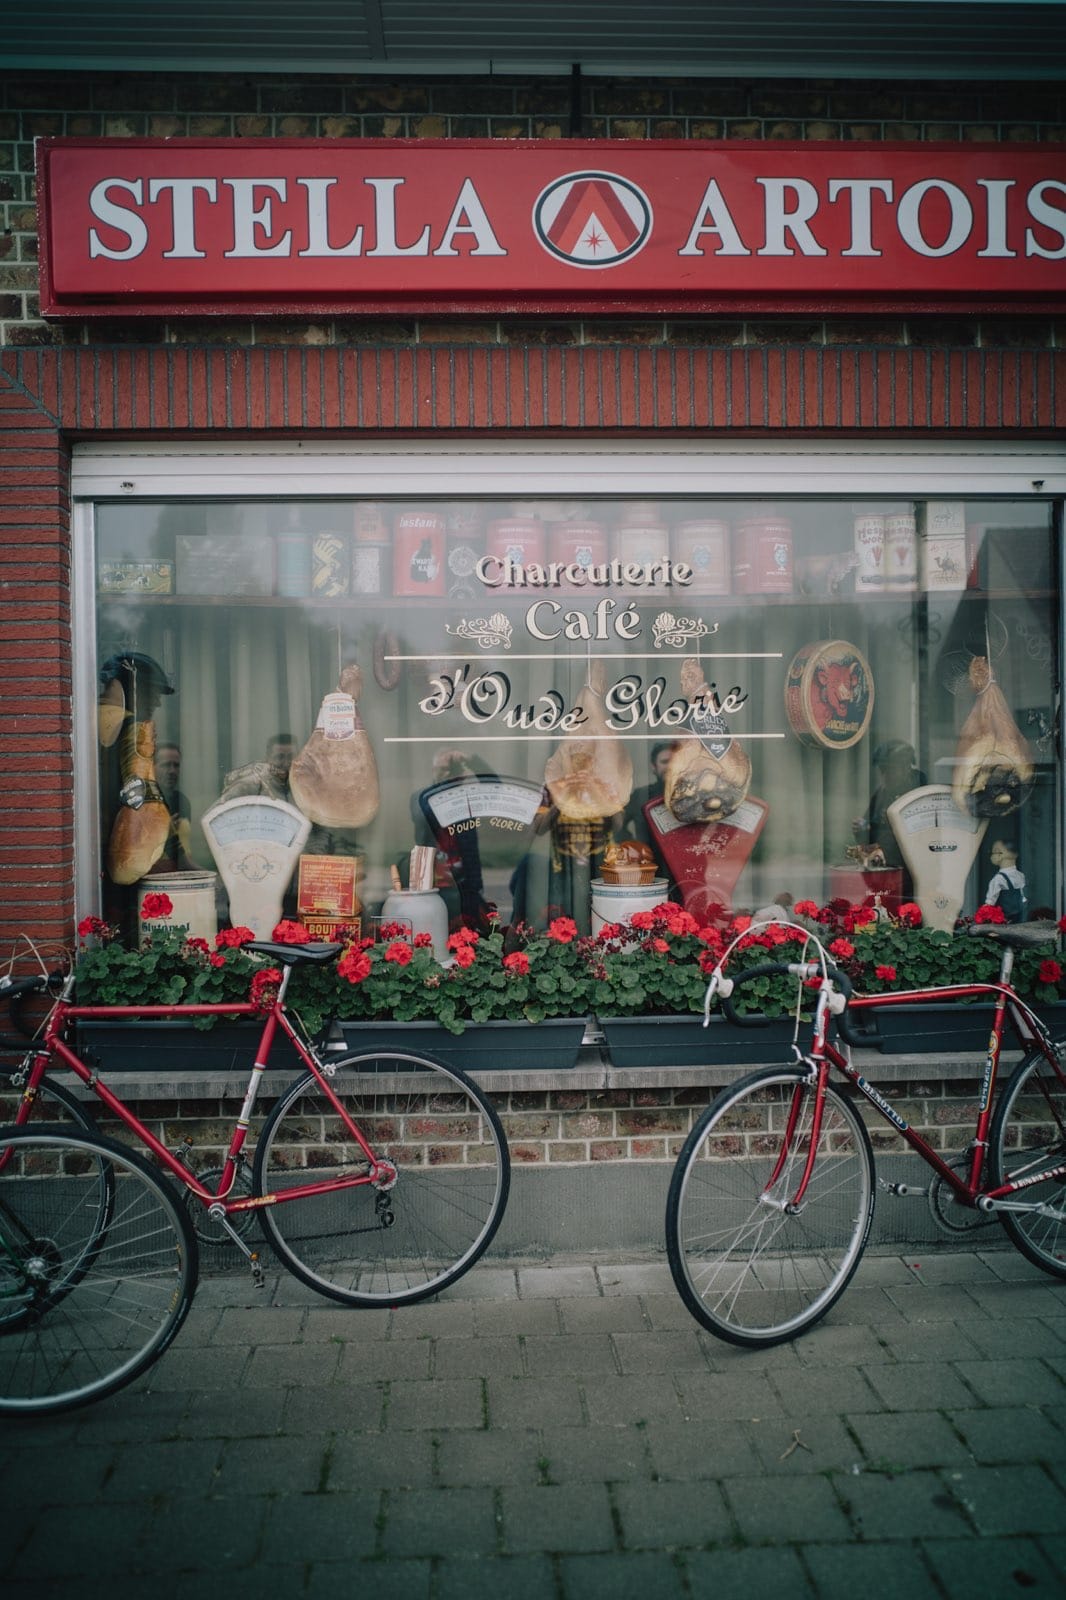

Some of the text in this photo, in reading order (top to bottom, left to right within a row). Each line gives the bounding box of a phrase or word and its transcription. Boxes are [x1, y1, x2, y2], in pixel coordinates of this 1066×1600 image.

[89, 177, 1066, 260] STELLA ARTOIS
[476, 555, 693, 587] Charcuterie
[525, 598, 642, 641] Café
[418, 664, 588, 733] d'Oude
[604, 675, 748, 731] Glorie
[447, 816, 525, 836] D'OUDE GLORIE
[863, 1081, 904, 1124] BENOTTO
[979, 1060, 992, 1109] BENOTTO
